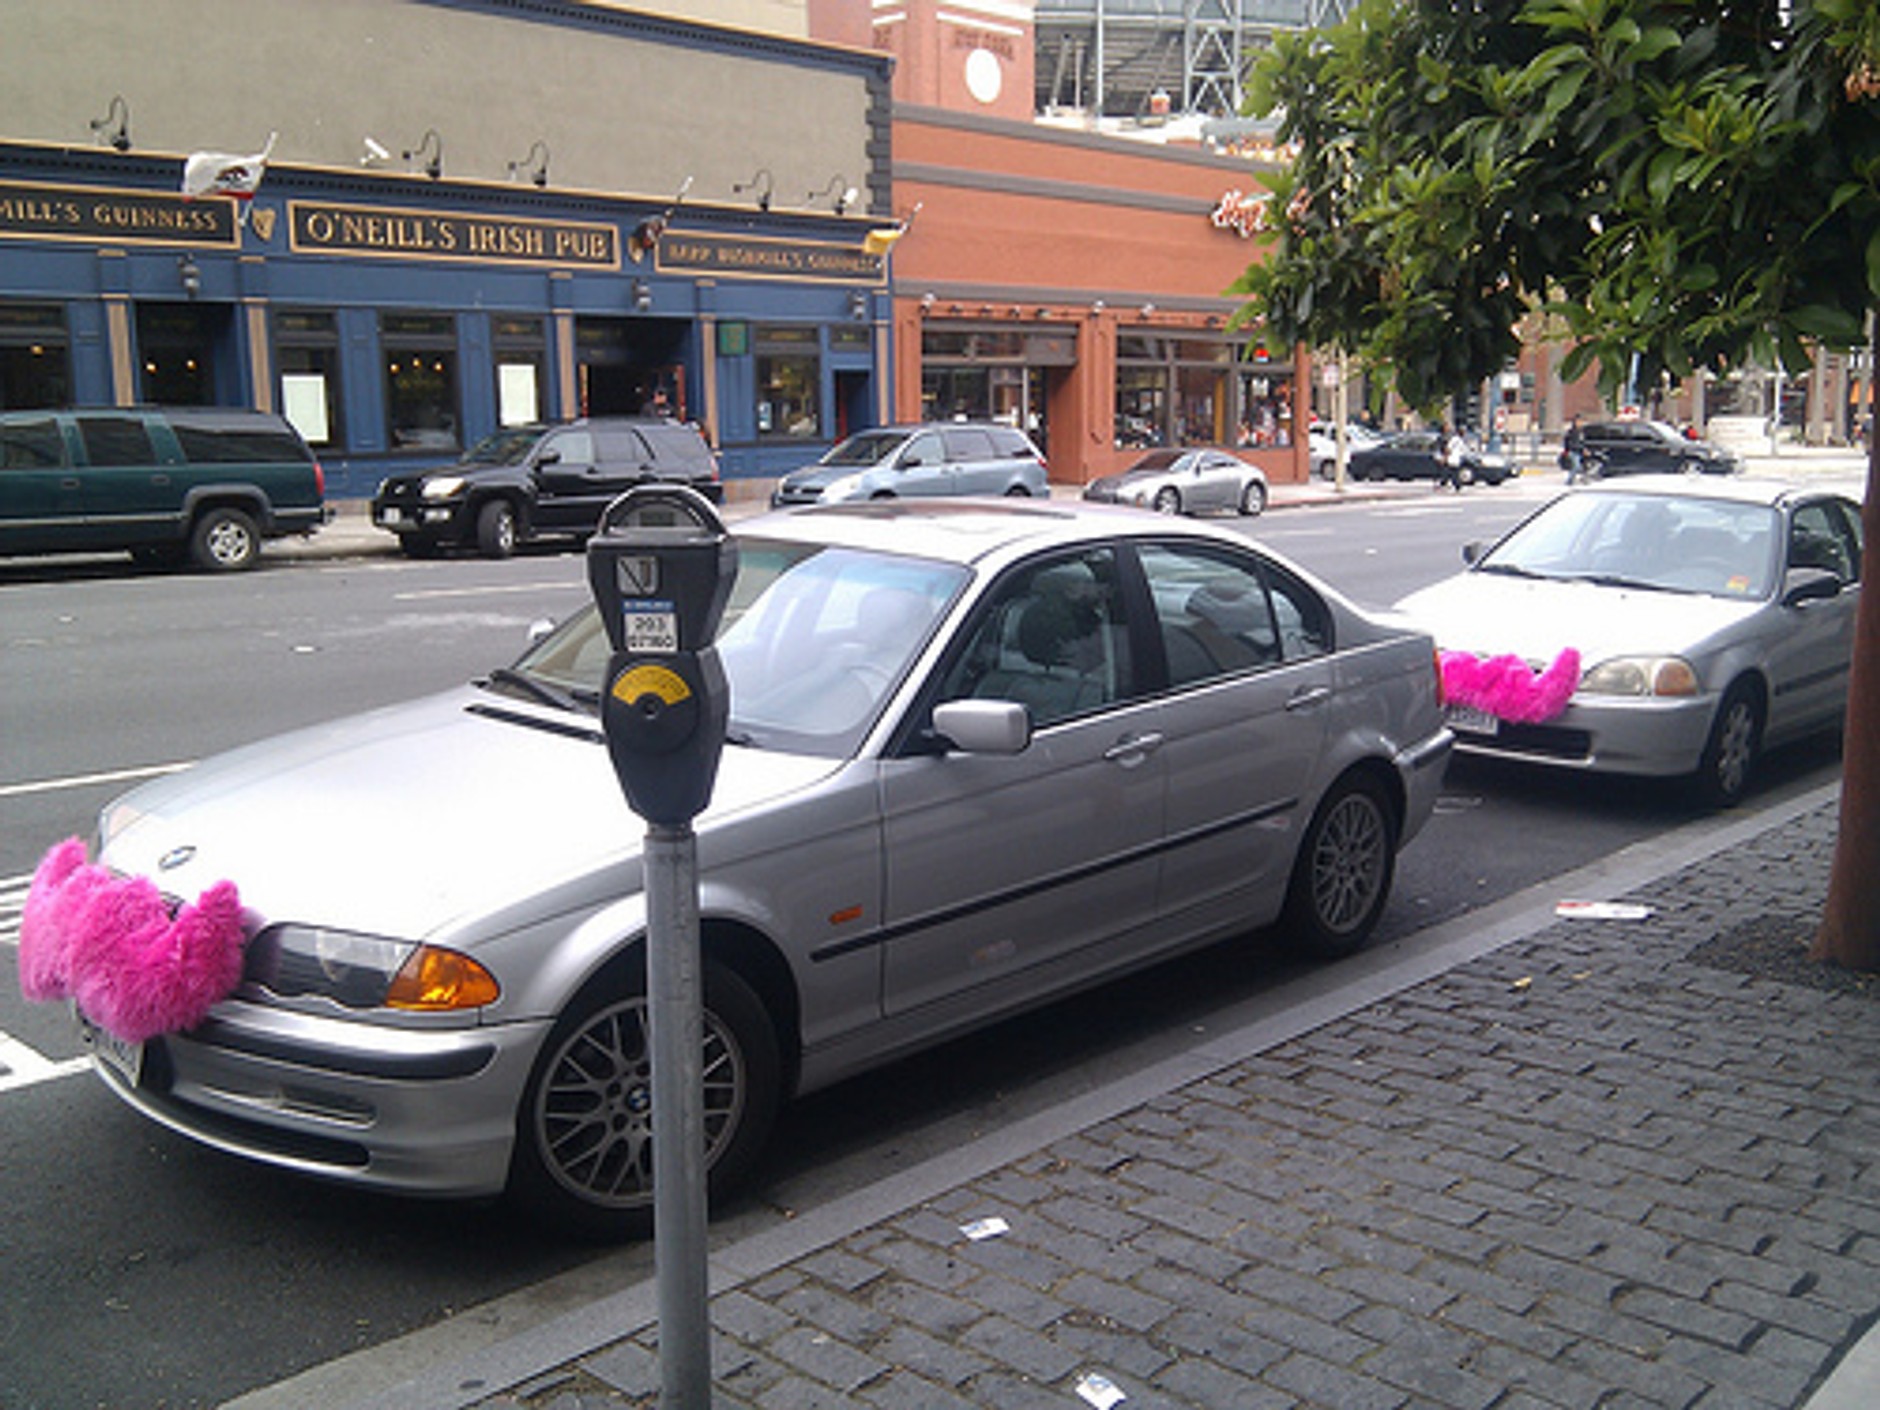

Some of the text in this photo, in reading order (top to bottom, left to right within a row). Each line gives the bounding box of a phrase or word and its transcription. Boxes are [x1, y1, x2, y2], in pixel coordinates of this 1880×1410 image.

[93, 203, 218, 231] GUINNESS
[306, 212, 607, 259] O'NEILL'S IRISH PUB
